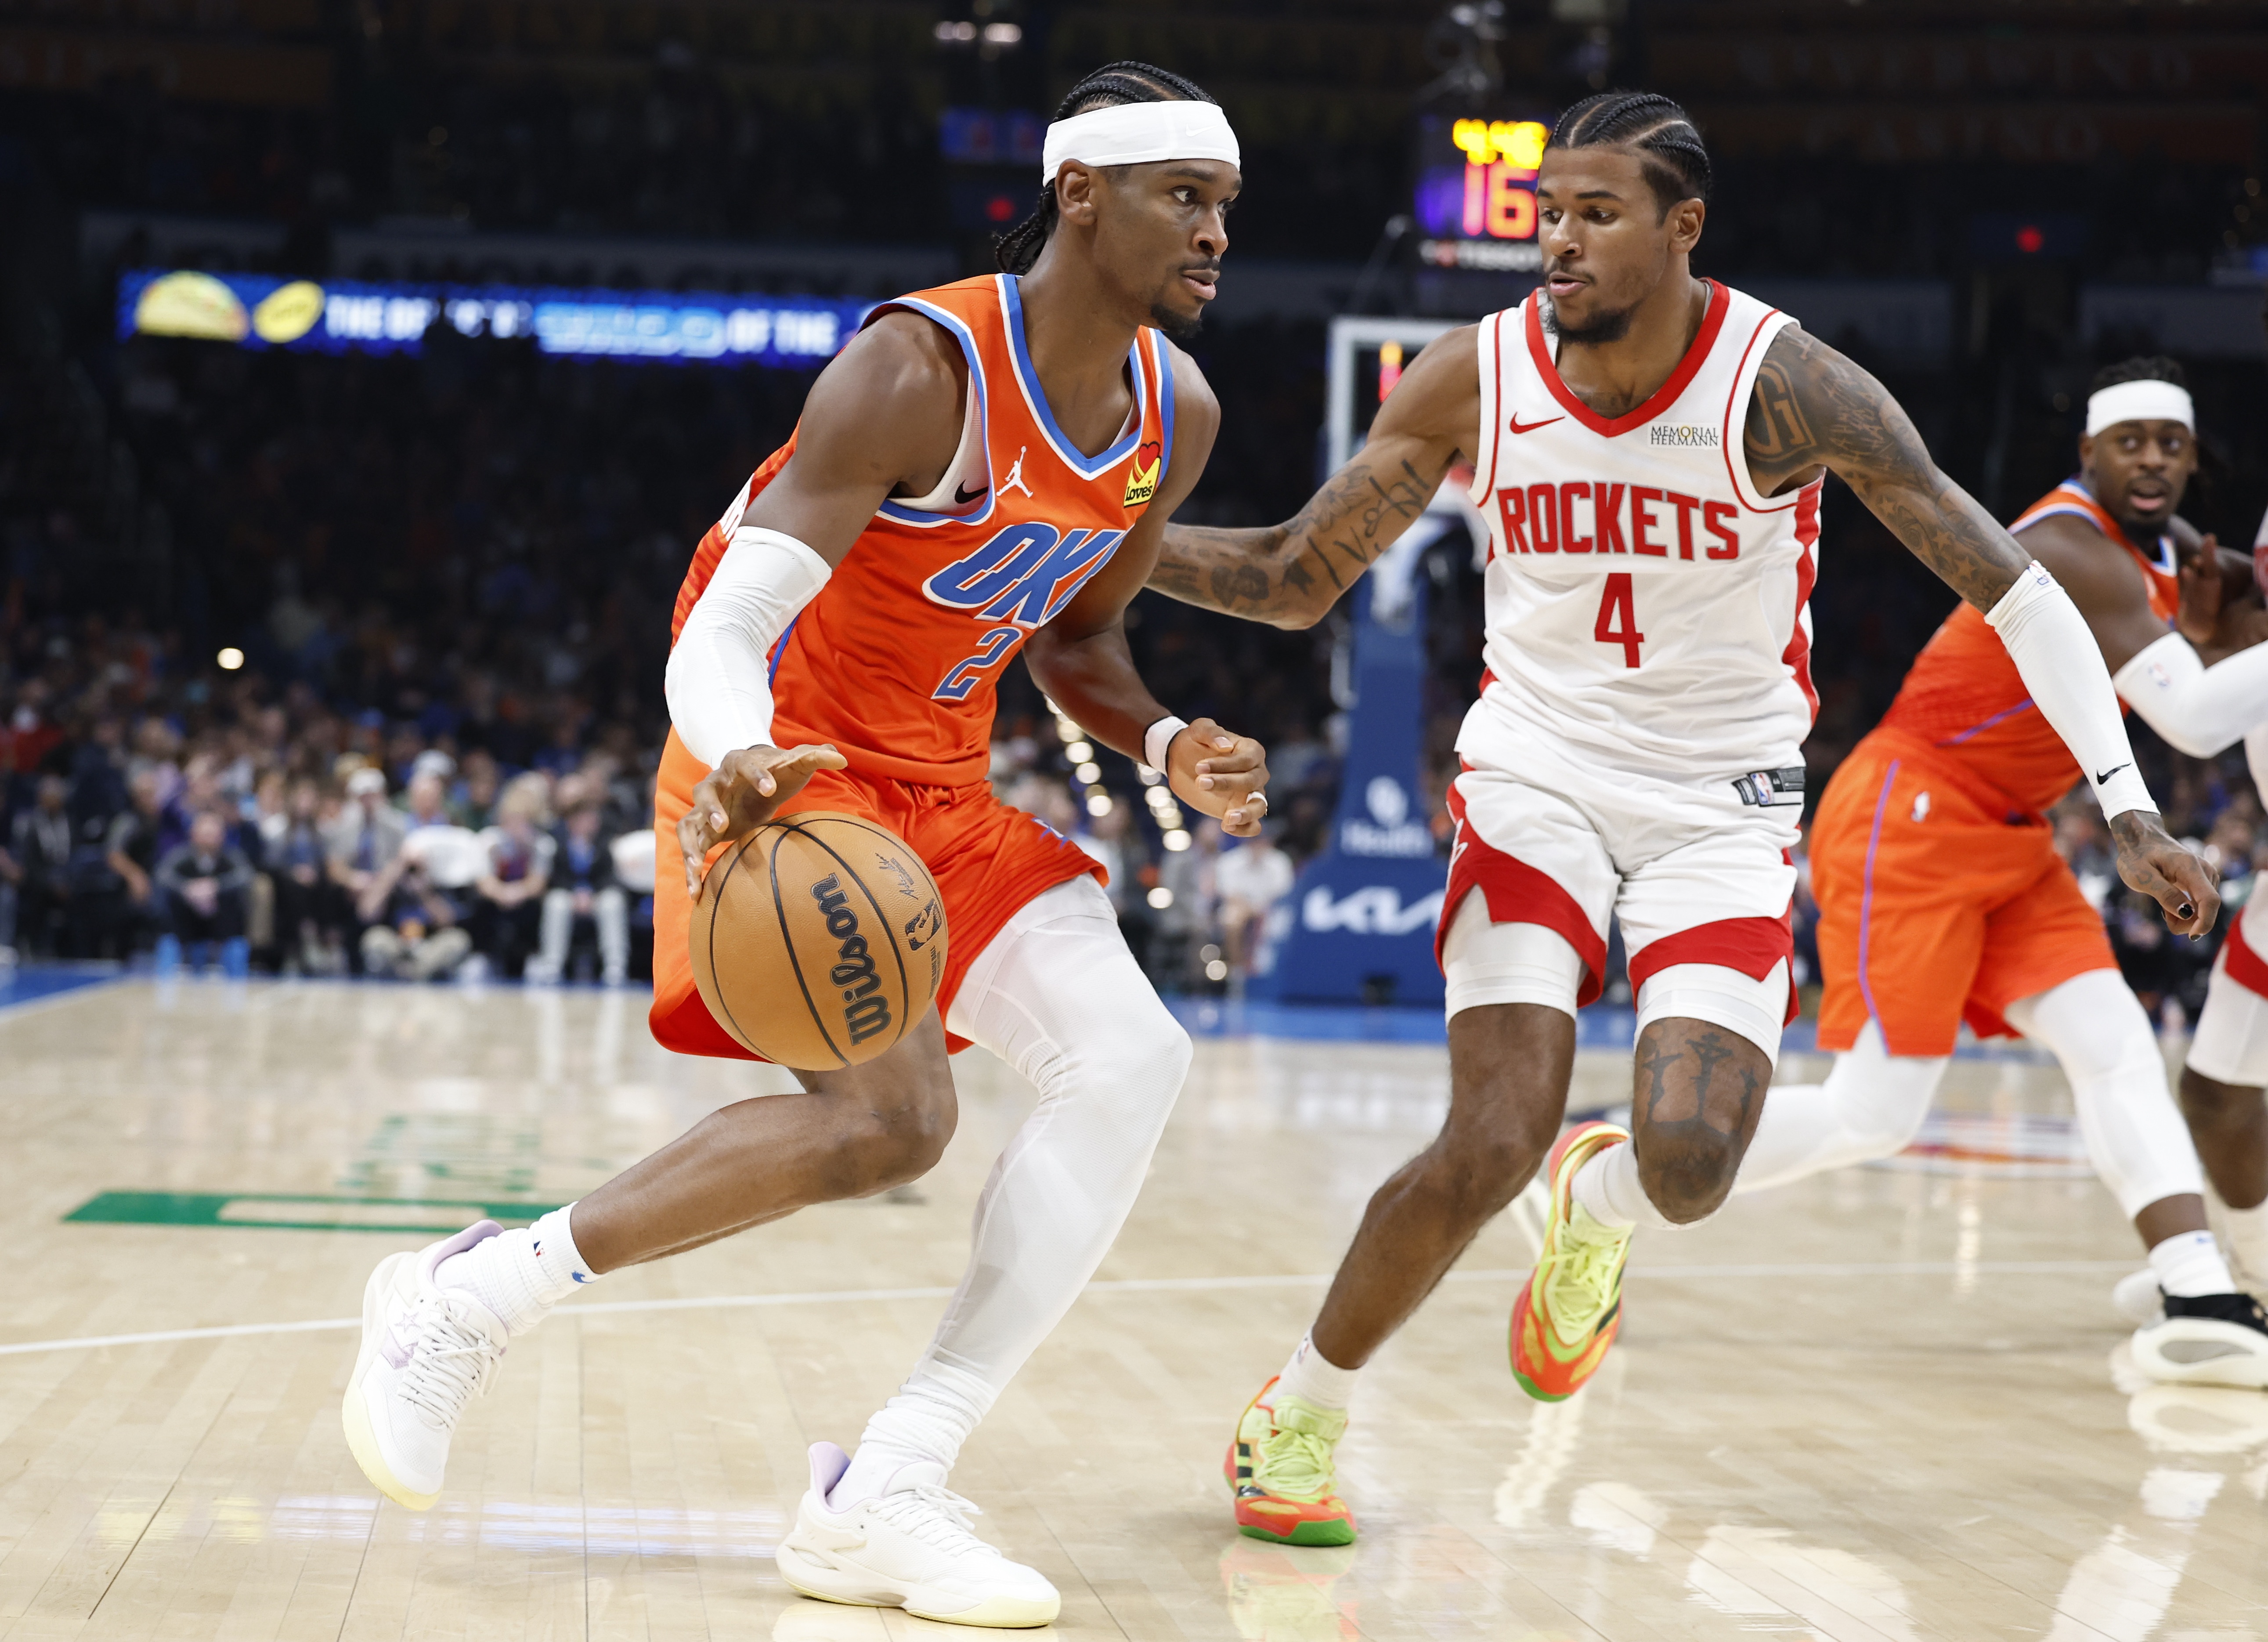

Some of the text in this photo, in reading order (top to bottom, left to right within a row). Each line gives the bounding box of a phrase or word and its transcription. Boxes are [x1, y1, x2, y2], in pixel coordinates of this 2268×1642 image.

[1463, 160, 1538, 239] 16
[1650, 434, 1719, 446] HERMANN
[1651, 425, 1719, 438] MEMORIAL
[1495, 481, 1740, 561] ROCKETS
[1594, 572, 1645, 668] 4
[930, 626, 1023, 701] 2
[810, 872, 892, 1046] Wilson
